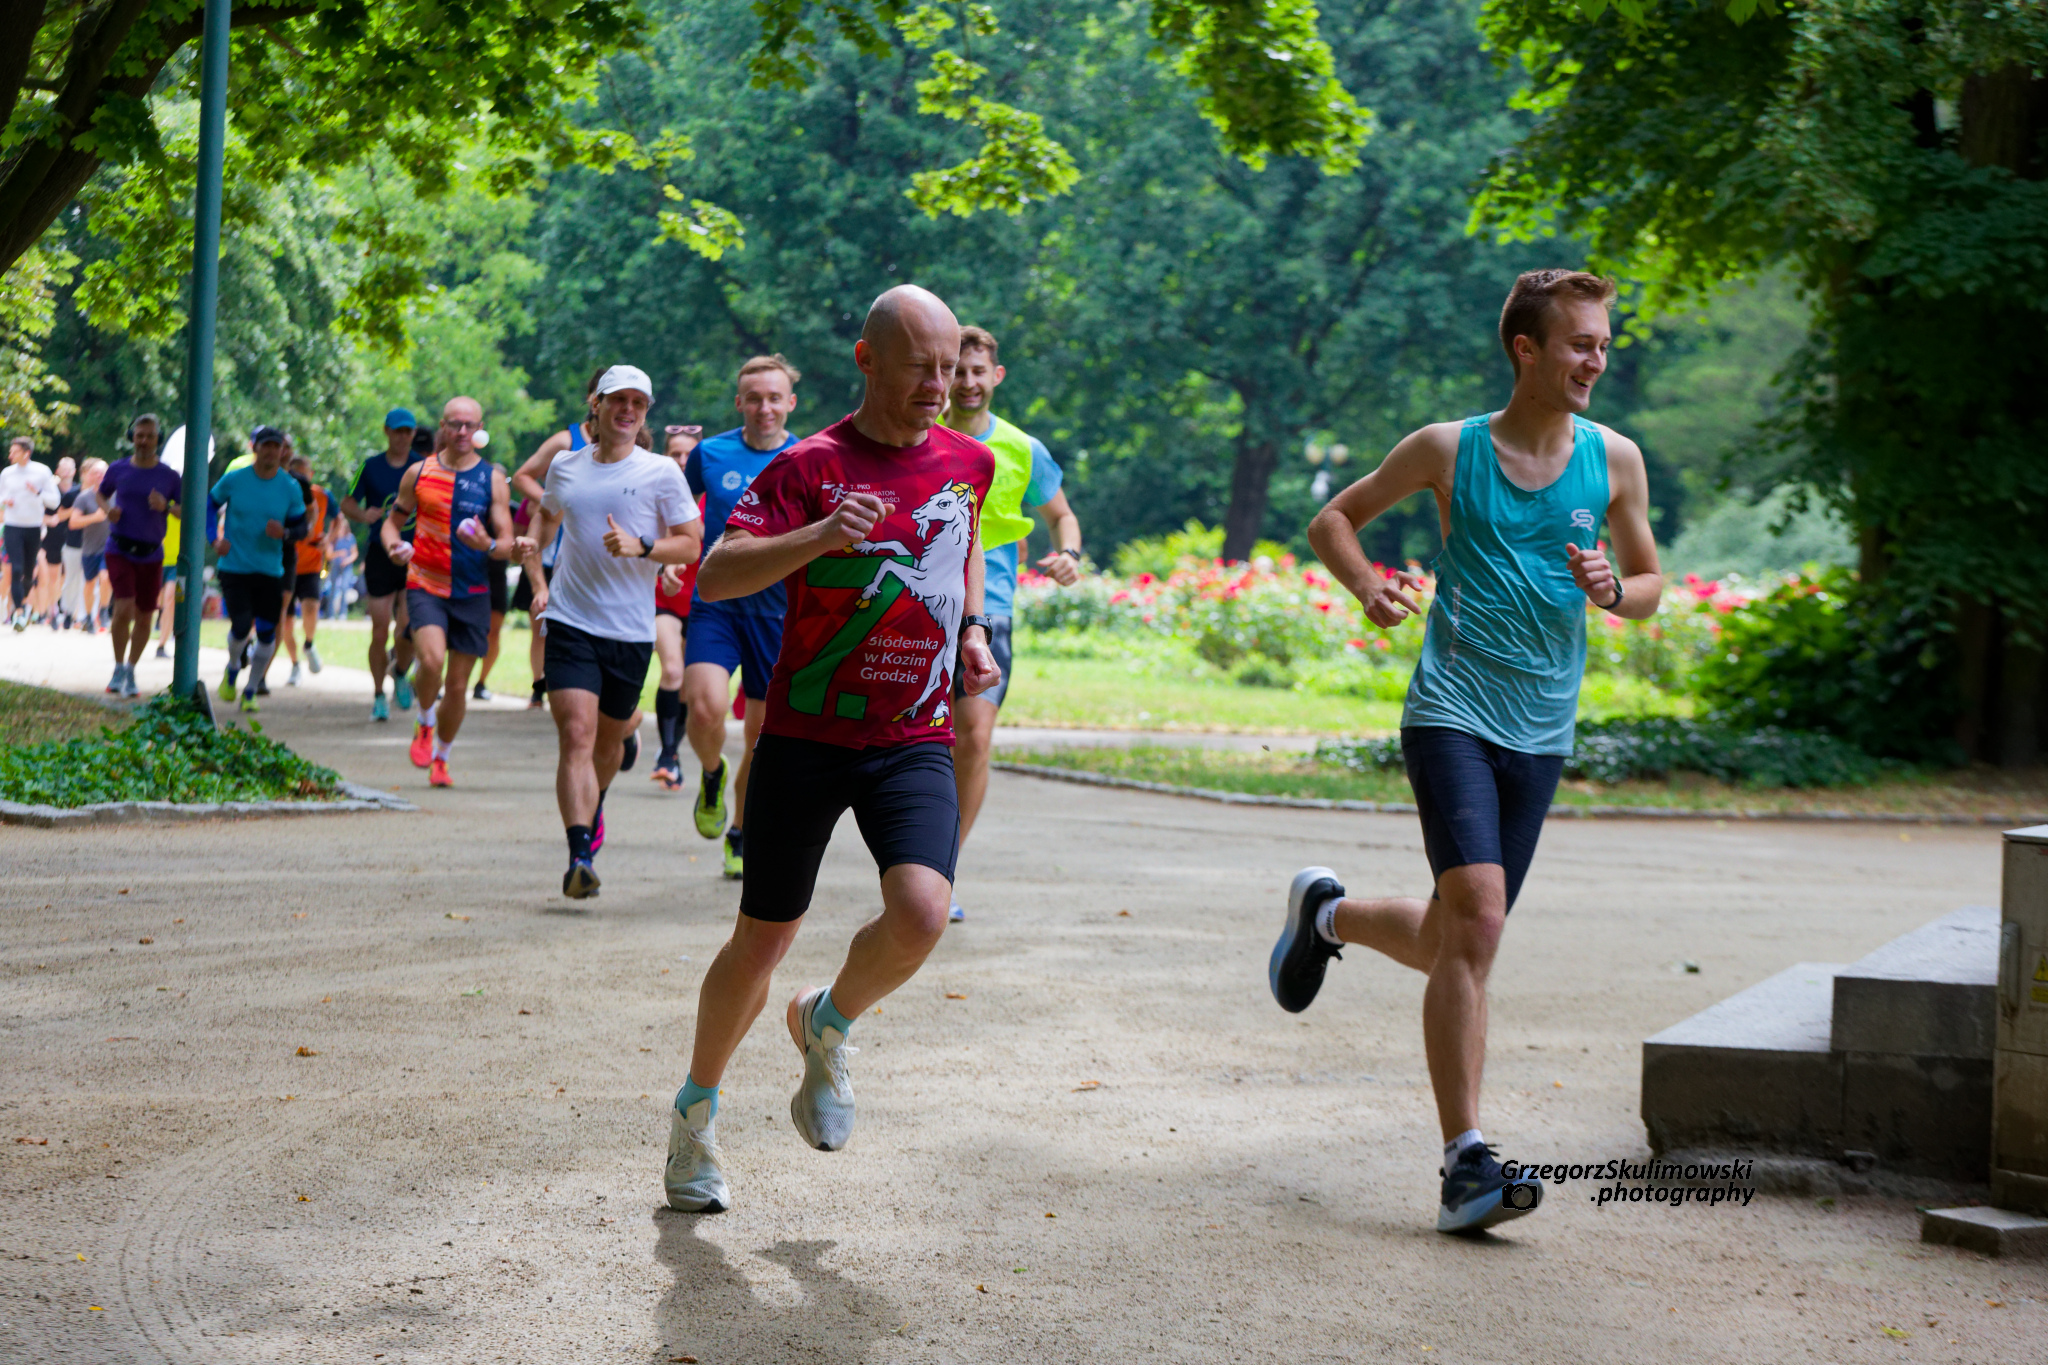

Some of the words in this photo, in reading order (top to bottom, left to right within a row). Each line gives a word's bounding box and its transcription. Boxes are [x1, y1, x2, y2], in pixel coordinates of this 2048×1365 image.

[731, 509, 764, 526] ARGO
[864, 652, 879, 663] w
[881, 651, 927, 667] Kozim
[860, 666, 919, 684] Grodzie
